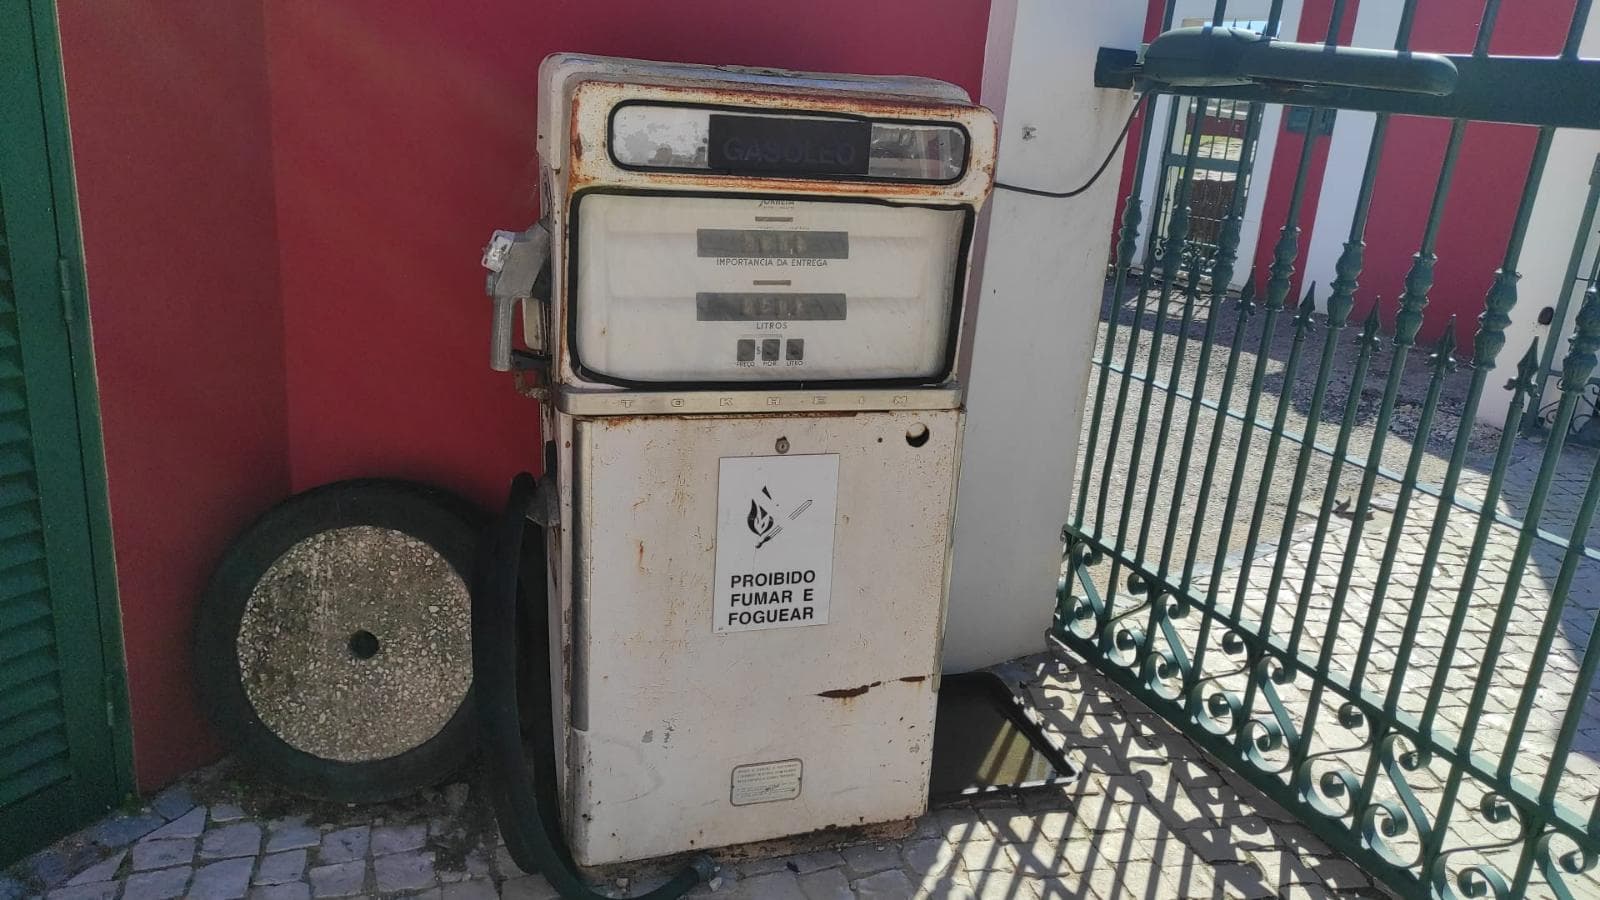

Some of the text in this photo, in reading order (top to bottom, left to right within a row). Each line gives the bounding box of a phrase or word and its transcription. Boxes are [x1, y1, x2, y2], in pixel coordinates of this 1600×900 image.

[776, 259, 788, 267] DA
[791, 259, 828, 267] ENTREGA
[756, 322, 788, 330] LITROS
[620, 394, 909, 408] TOKHEIM
[730, 569, 816, 588] PROIBIDO
[730, 588, 814, 607] FUMAR E
[728, 606, 814, 626] FOGUEAR
